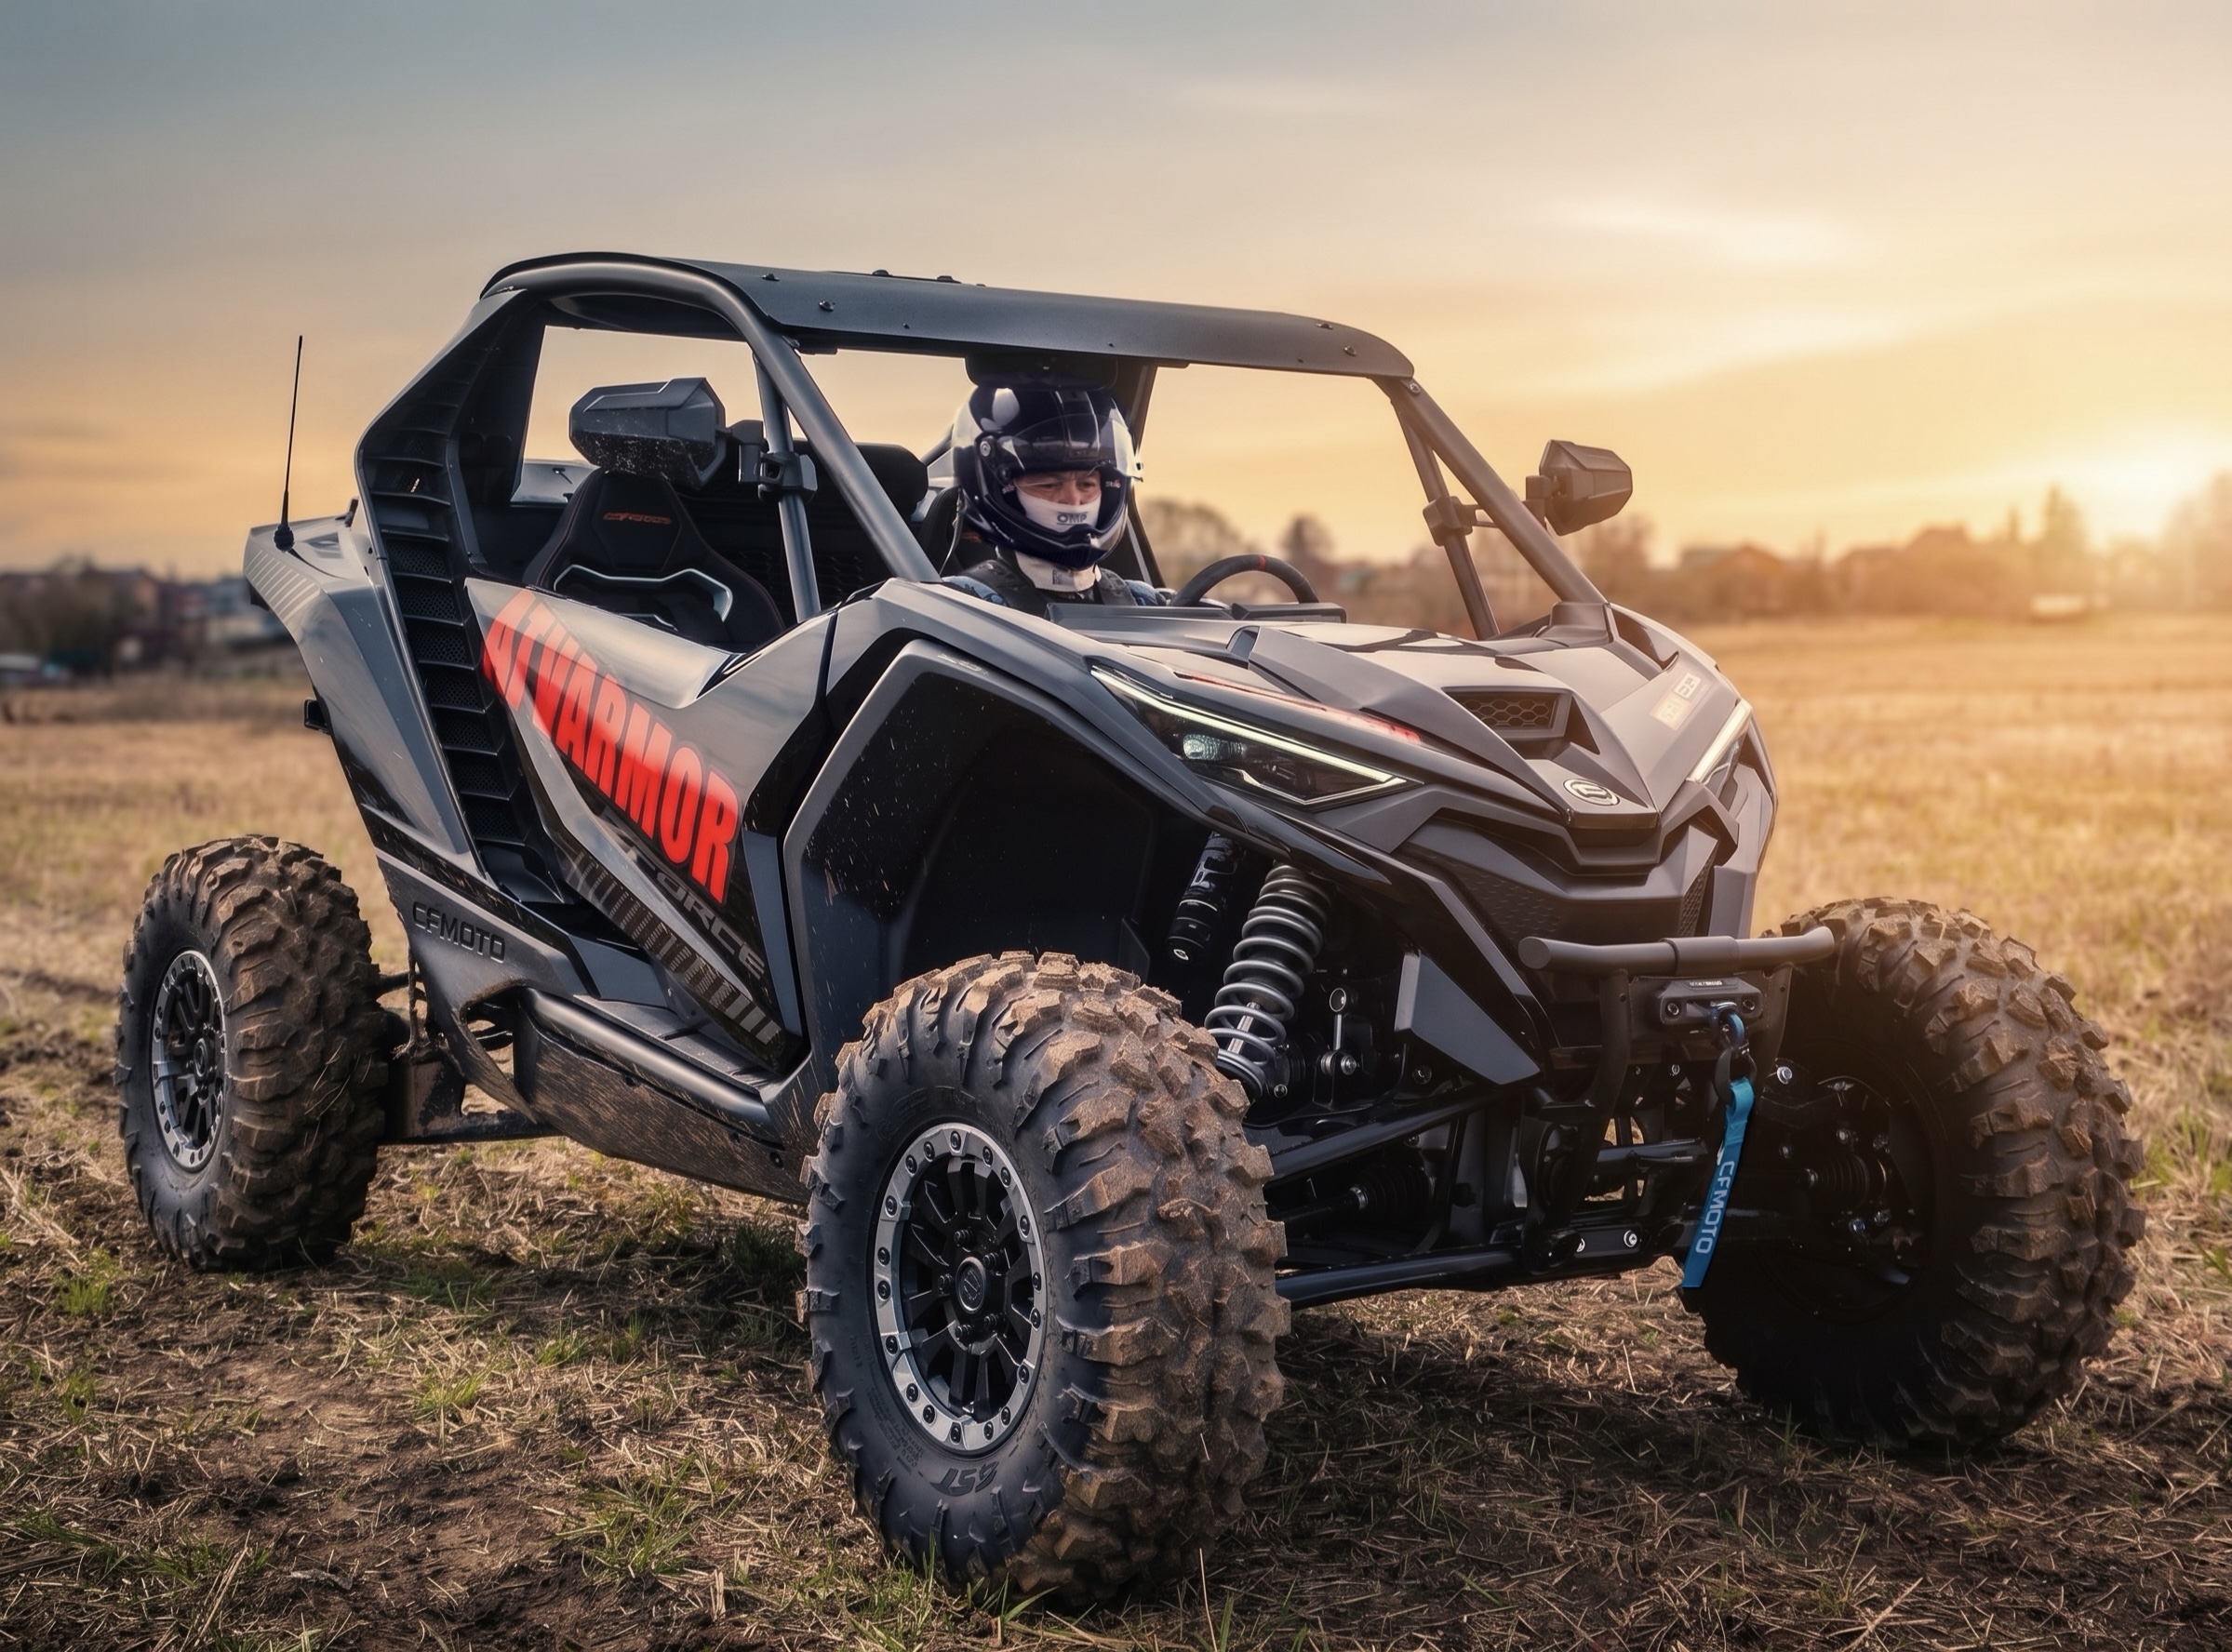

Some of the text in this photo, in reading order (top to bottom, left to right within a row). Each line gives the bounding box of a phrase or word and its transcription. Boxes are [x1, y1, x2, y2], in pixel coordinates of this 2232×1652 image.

[1057, 513, 1088, 524] OMP
[483, 588, 740, 904] ATVARMOR
[412, 901, 505, 964] CFMOTO
[1695, 1160, 1735, 1254] CFMOTO
